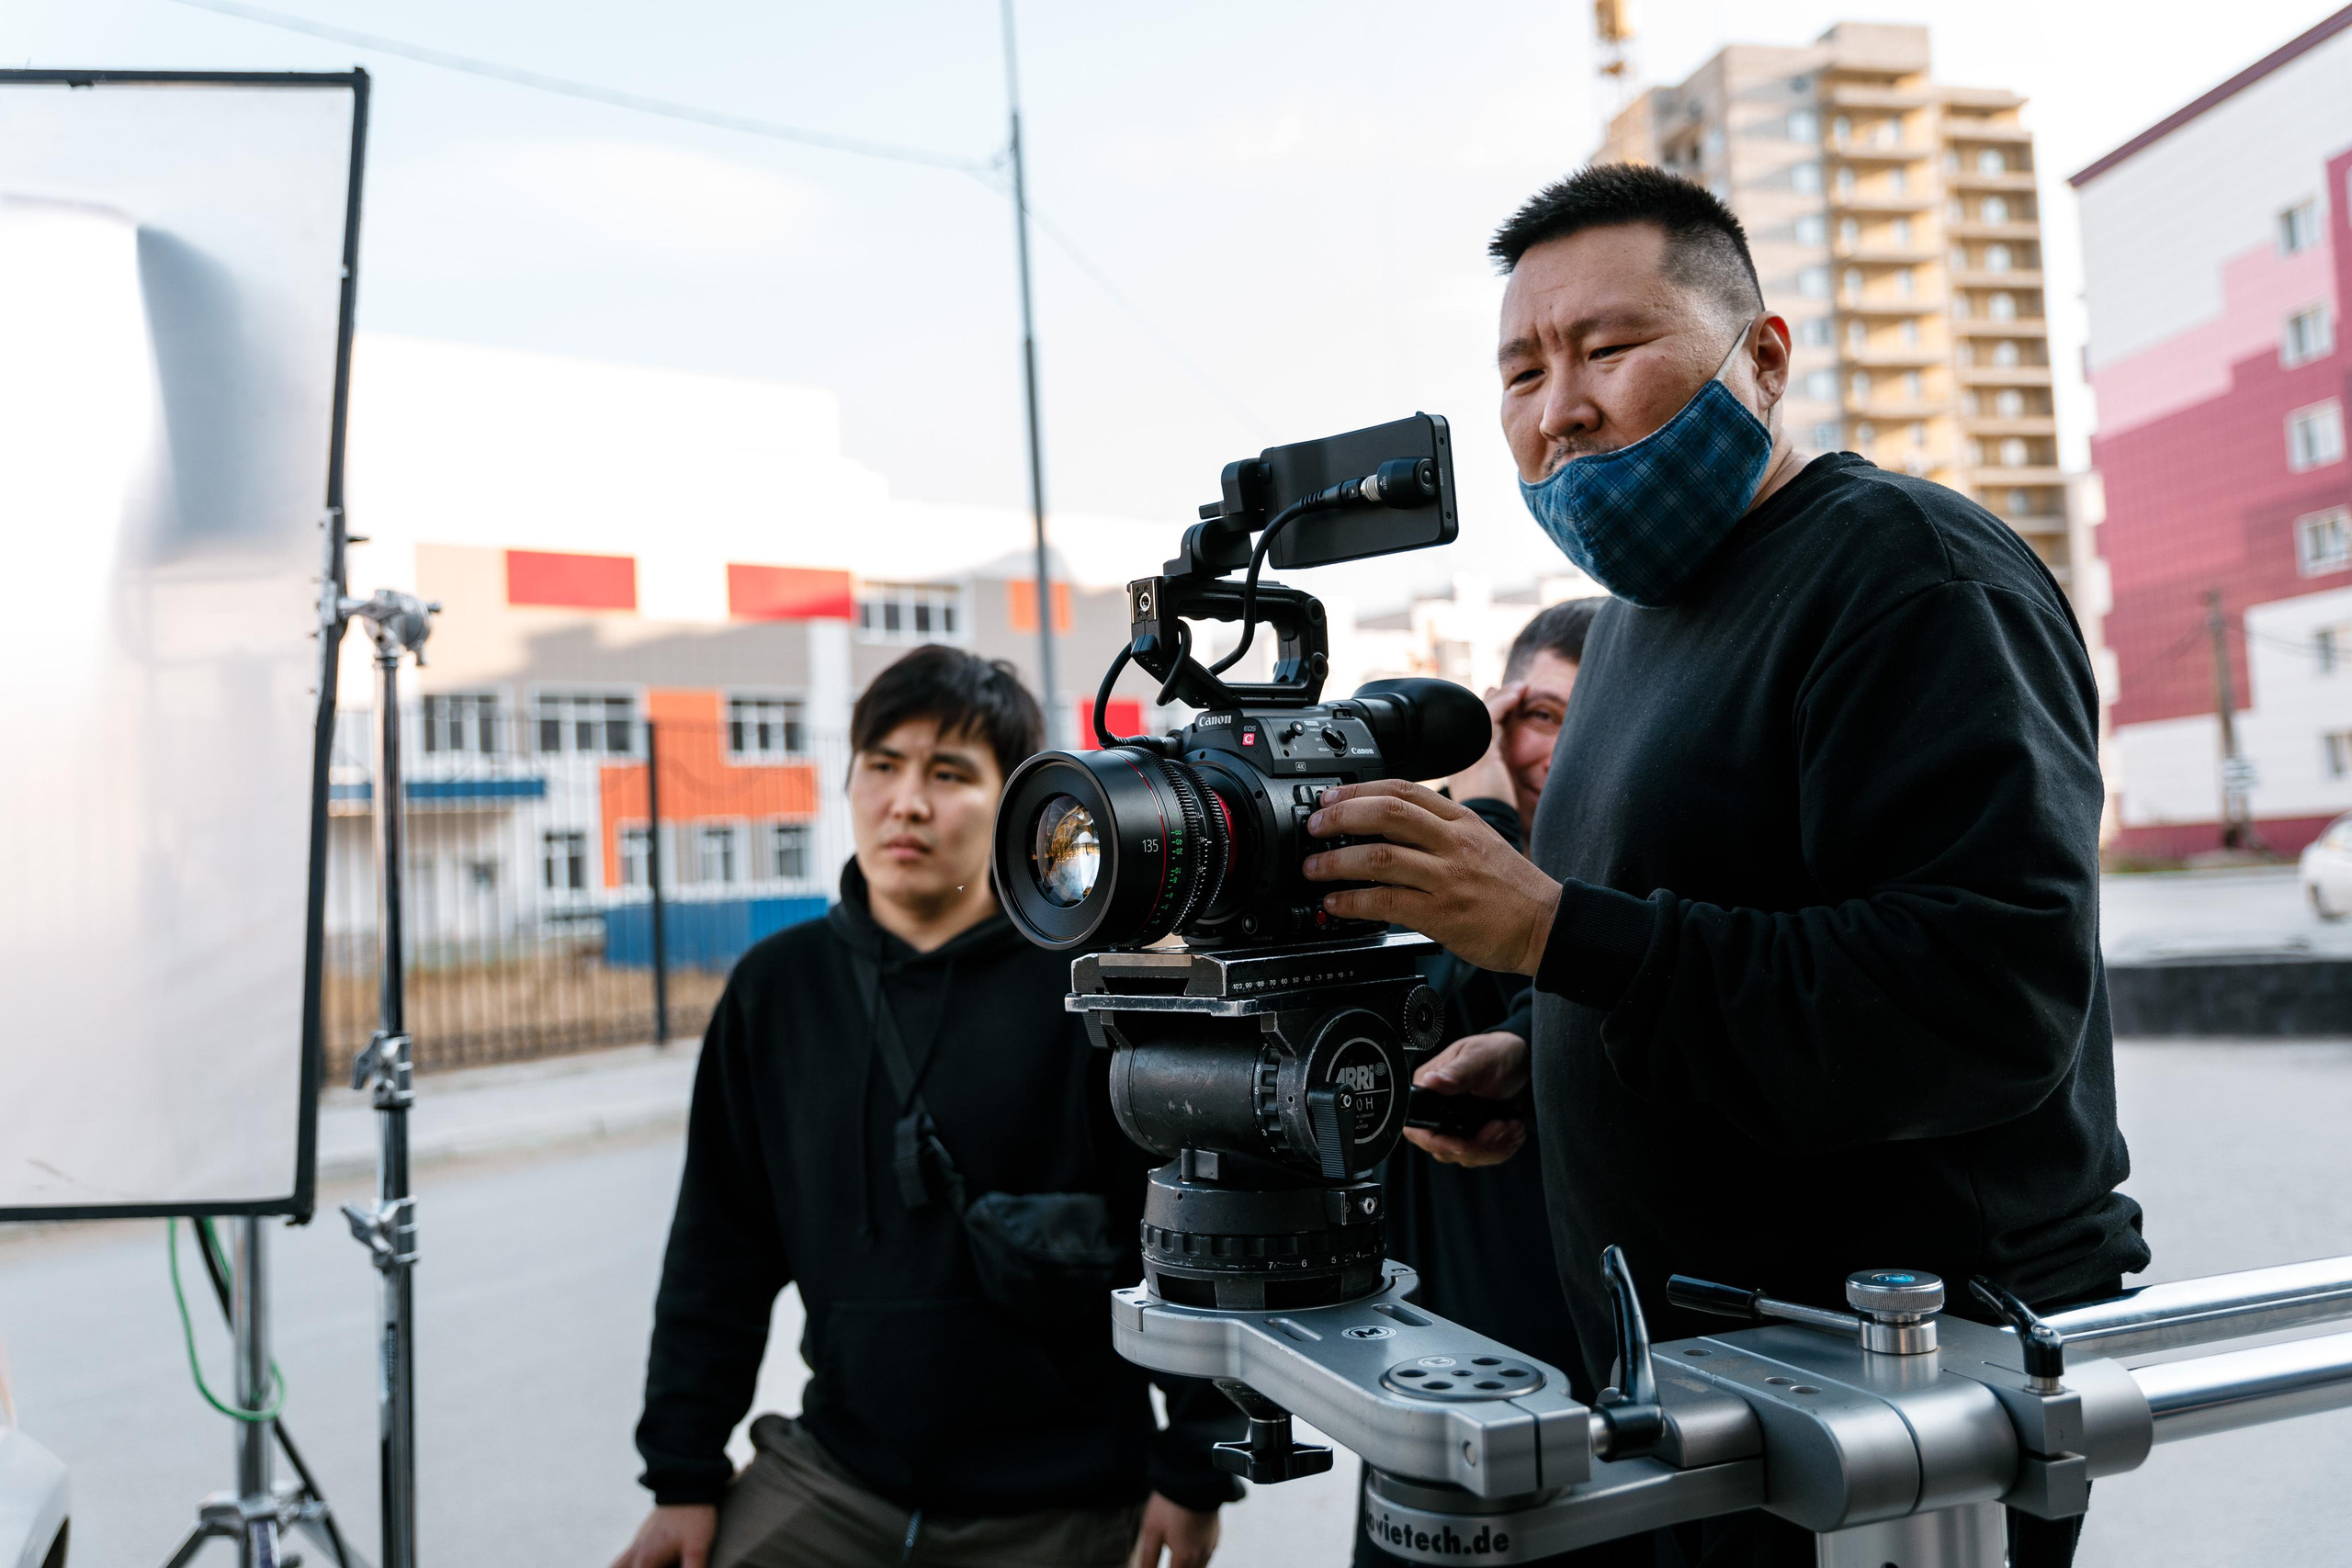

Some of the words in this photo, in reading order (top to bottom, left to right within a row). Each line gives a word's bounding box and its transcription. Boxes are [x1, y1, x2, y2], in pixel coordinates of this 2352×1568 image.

[1198, 715, 1232, 728] Canon
[1244, 734, 1252, 744] C
[1351, 747, 1374, 755] Canon
[1142, 839, 1159, 853] 135
[1256, 1064, 1261, 1073] 6
[1254, 1086, 1260, 1095] 5
[1256, 1108, 1261, 1116] 4
[1261, 1128, 1268, 1136] 3
[1268, 1261, 1274, 1269] 7
[1301, 1259, 1307, 1268] 6
[1330, 1256, 1337, 1264] 5
[1366, 1511, 1510, 1555] ovietech.de
